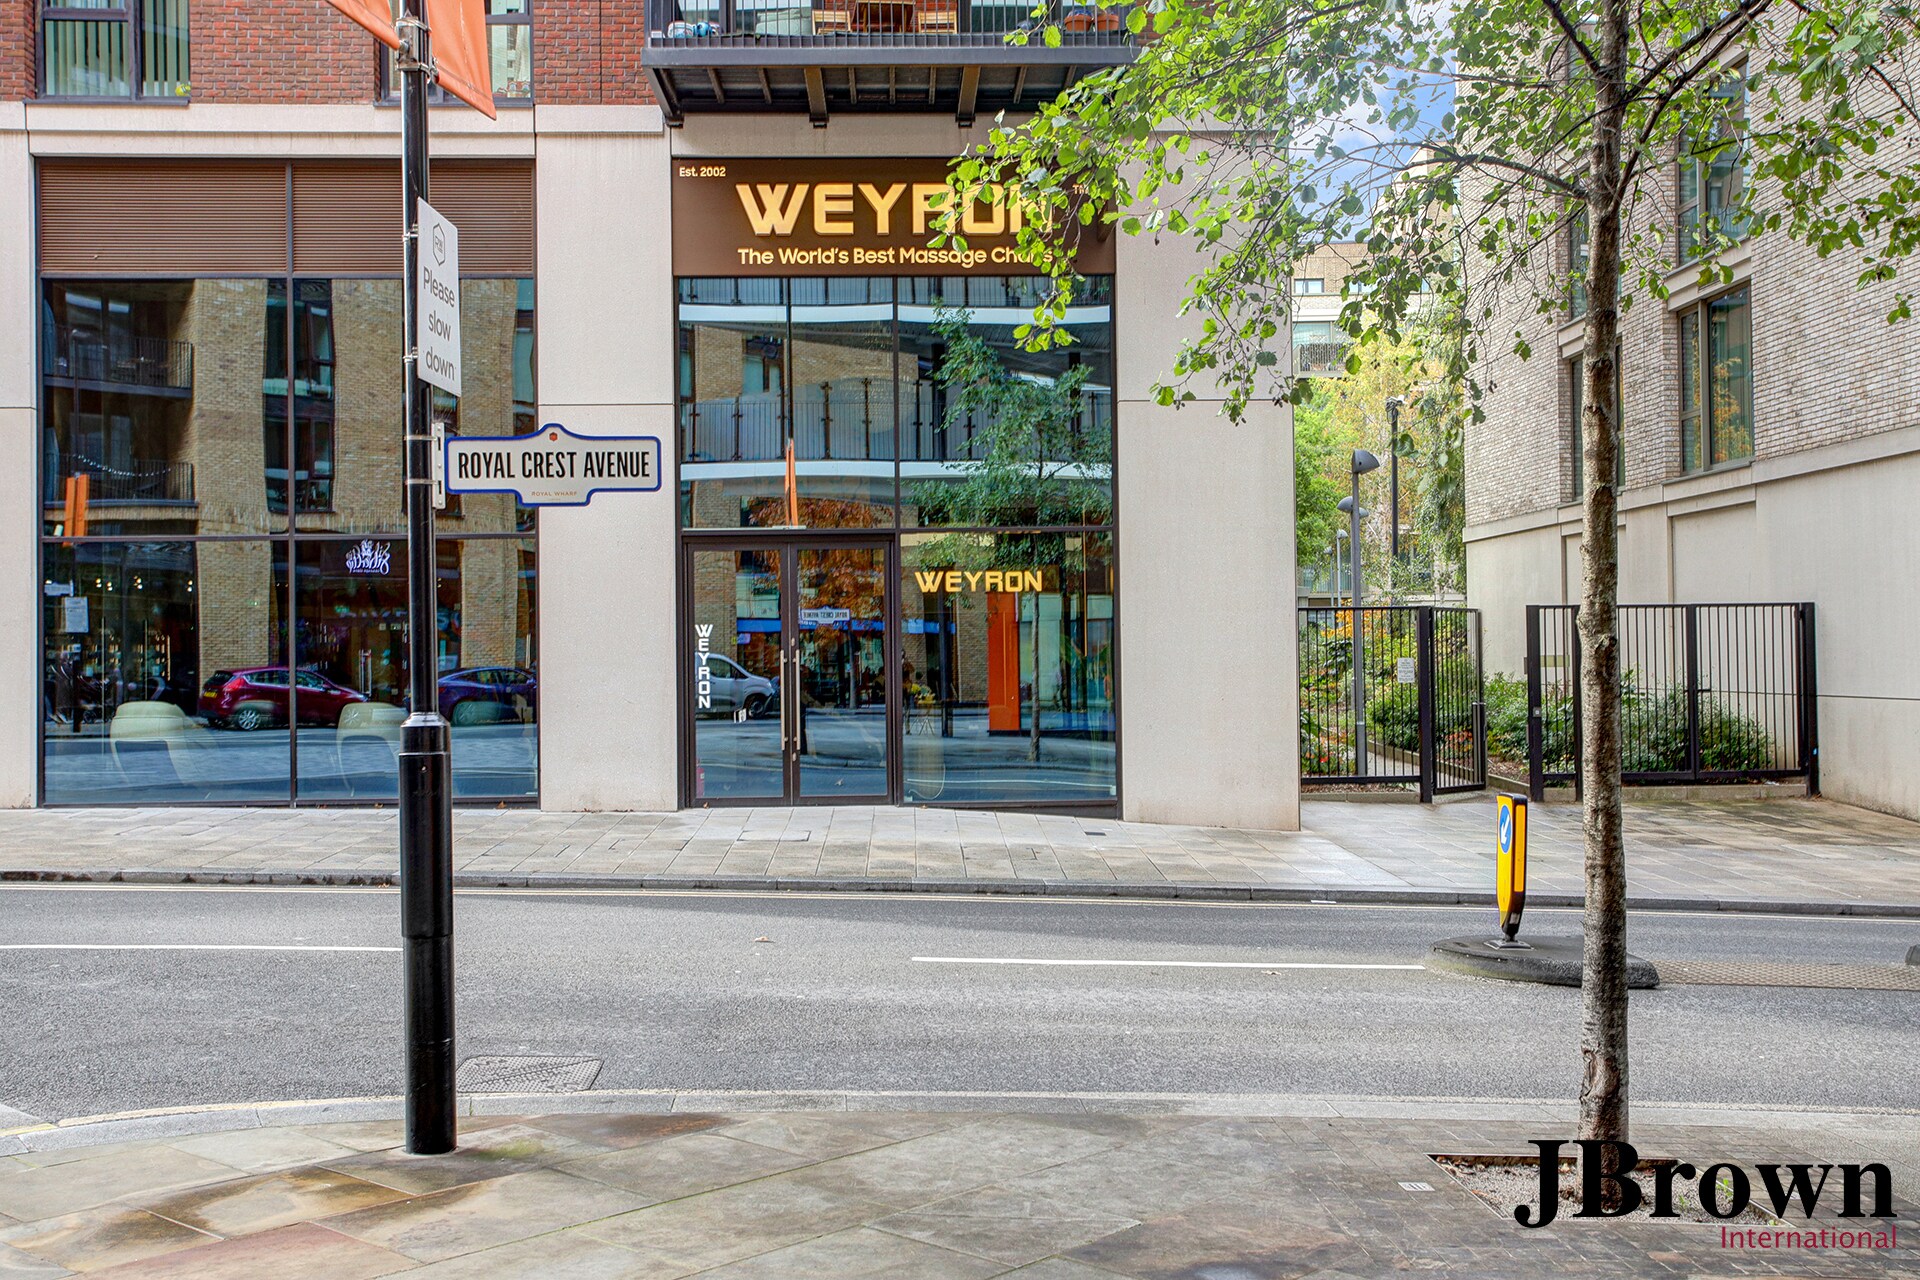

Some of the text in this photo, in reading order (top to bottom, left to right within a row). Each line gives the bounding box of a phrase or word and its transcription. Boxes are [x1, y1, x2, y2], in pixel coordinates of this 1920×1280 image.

[679, 166, 726, 177] Est. 2002
[738, 247, 774, 265] The
[777, 247, 849, 265] World's
[853, 247, 895, 265] Best
[899, 247, 987, 268] Massage
[423, 265, 455, 308] Please
[428, 312, 451, 342] slow
[425, 346, 455, 381] down
[458, 451, 650, 479] ROYAL CREST AVENUE
[914, 570, 1043, 593] WEYRON
[695, 624, 714, 709] WEYRON
